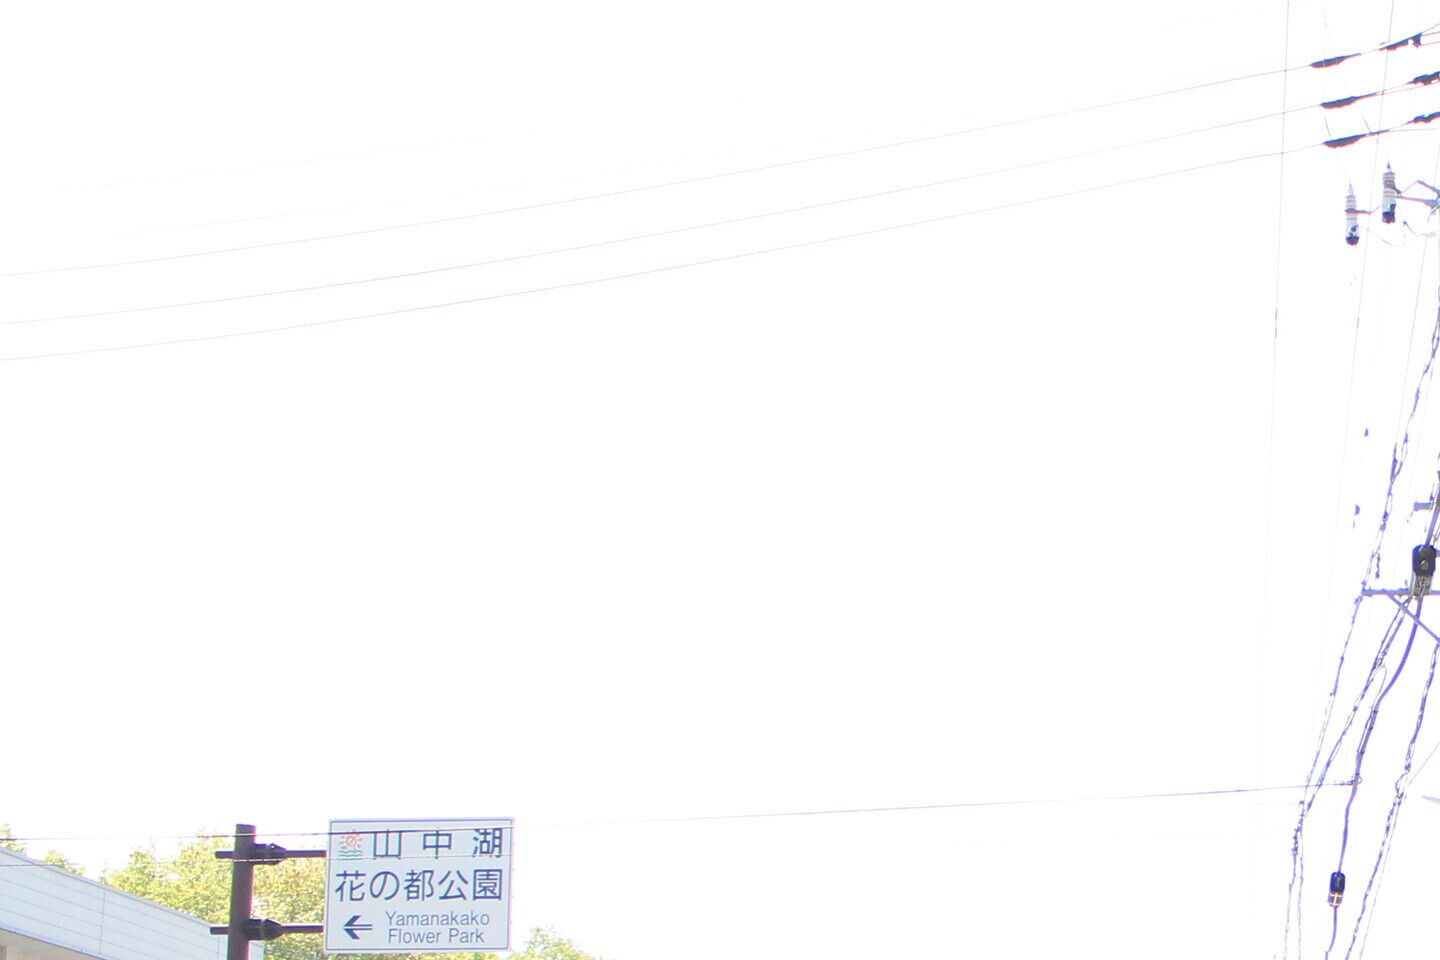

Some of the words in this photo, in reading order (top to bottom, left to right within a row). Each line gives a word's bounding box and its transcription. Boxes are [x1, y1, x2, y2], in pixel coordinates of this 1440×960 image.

[373, 827, 502, 860] 山中湖
[335, 868, 503, 902] 花の都公園
[385, 911, 490, 927] Yamanakako
[387, 928, 441, 944] Flower
[449, 928, 485, 943] Park
